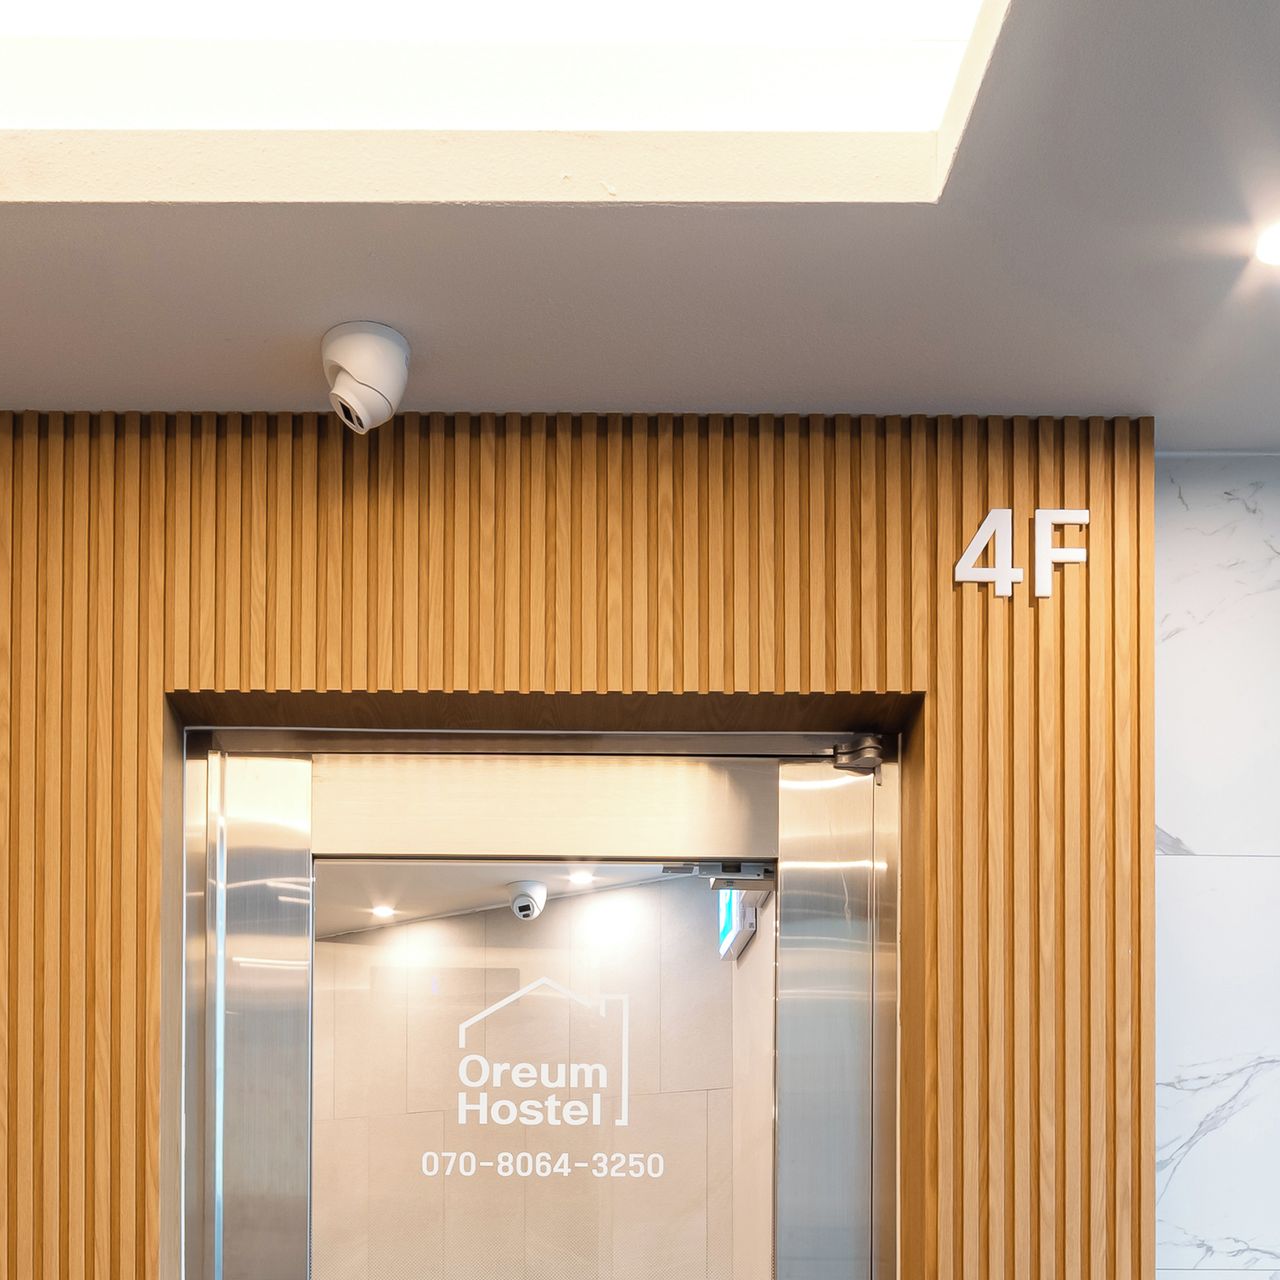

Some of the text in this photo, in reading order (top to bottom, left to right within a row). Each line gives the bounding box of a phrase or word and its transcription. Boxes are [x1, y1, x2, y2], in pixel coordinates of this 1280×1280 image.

[955, 508, 1090, 598] 4F
[458, 1053, 608, 1089] Oreum
[458, 1091, 602, 1126] Hostel
[421, 1151, 665, 1179] 070-8064-3250
